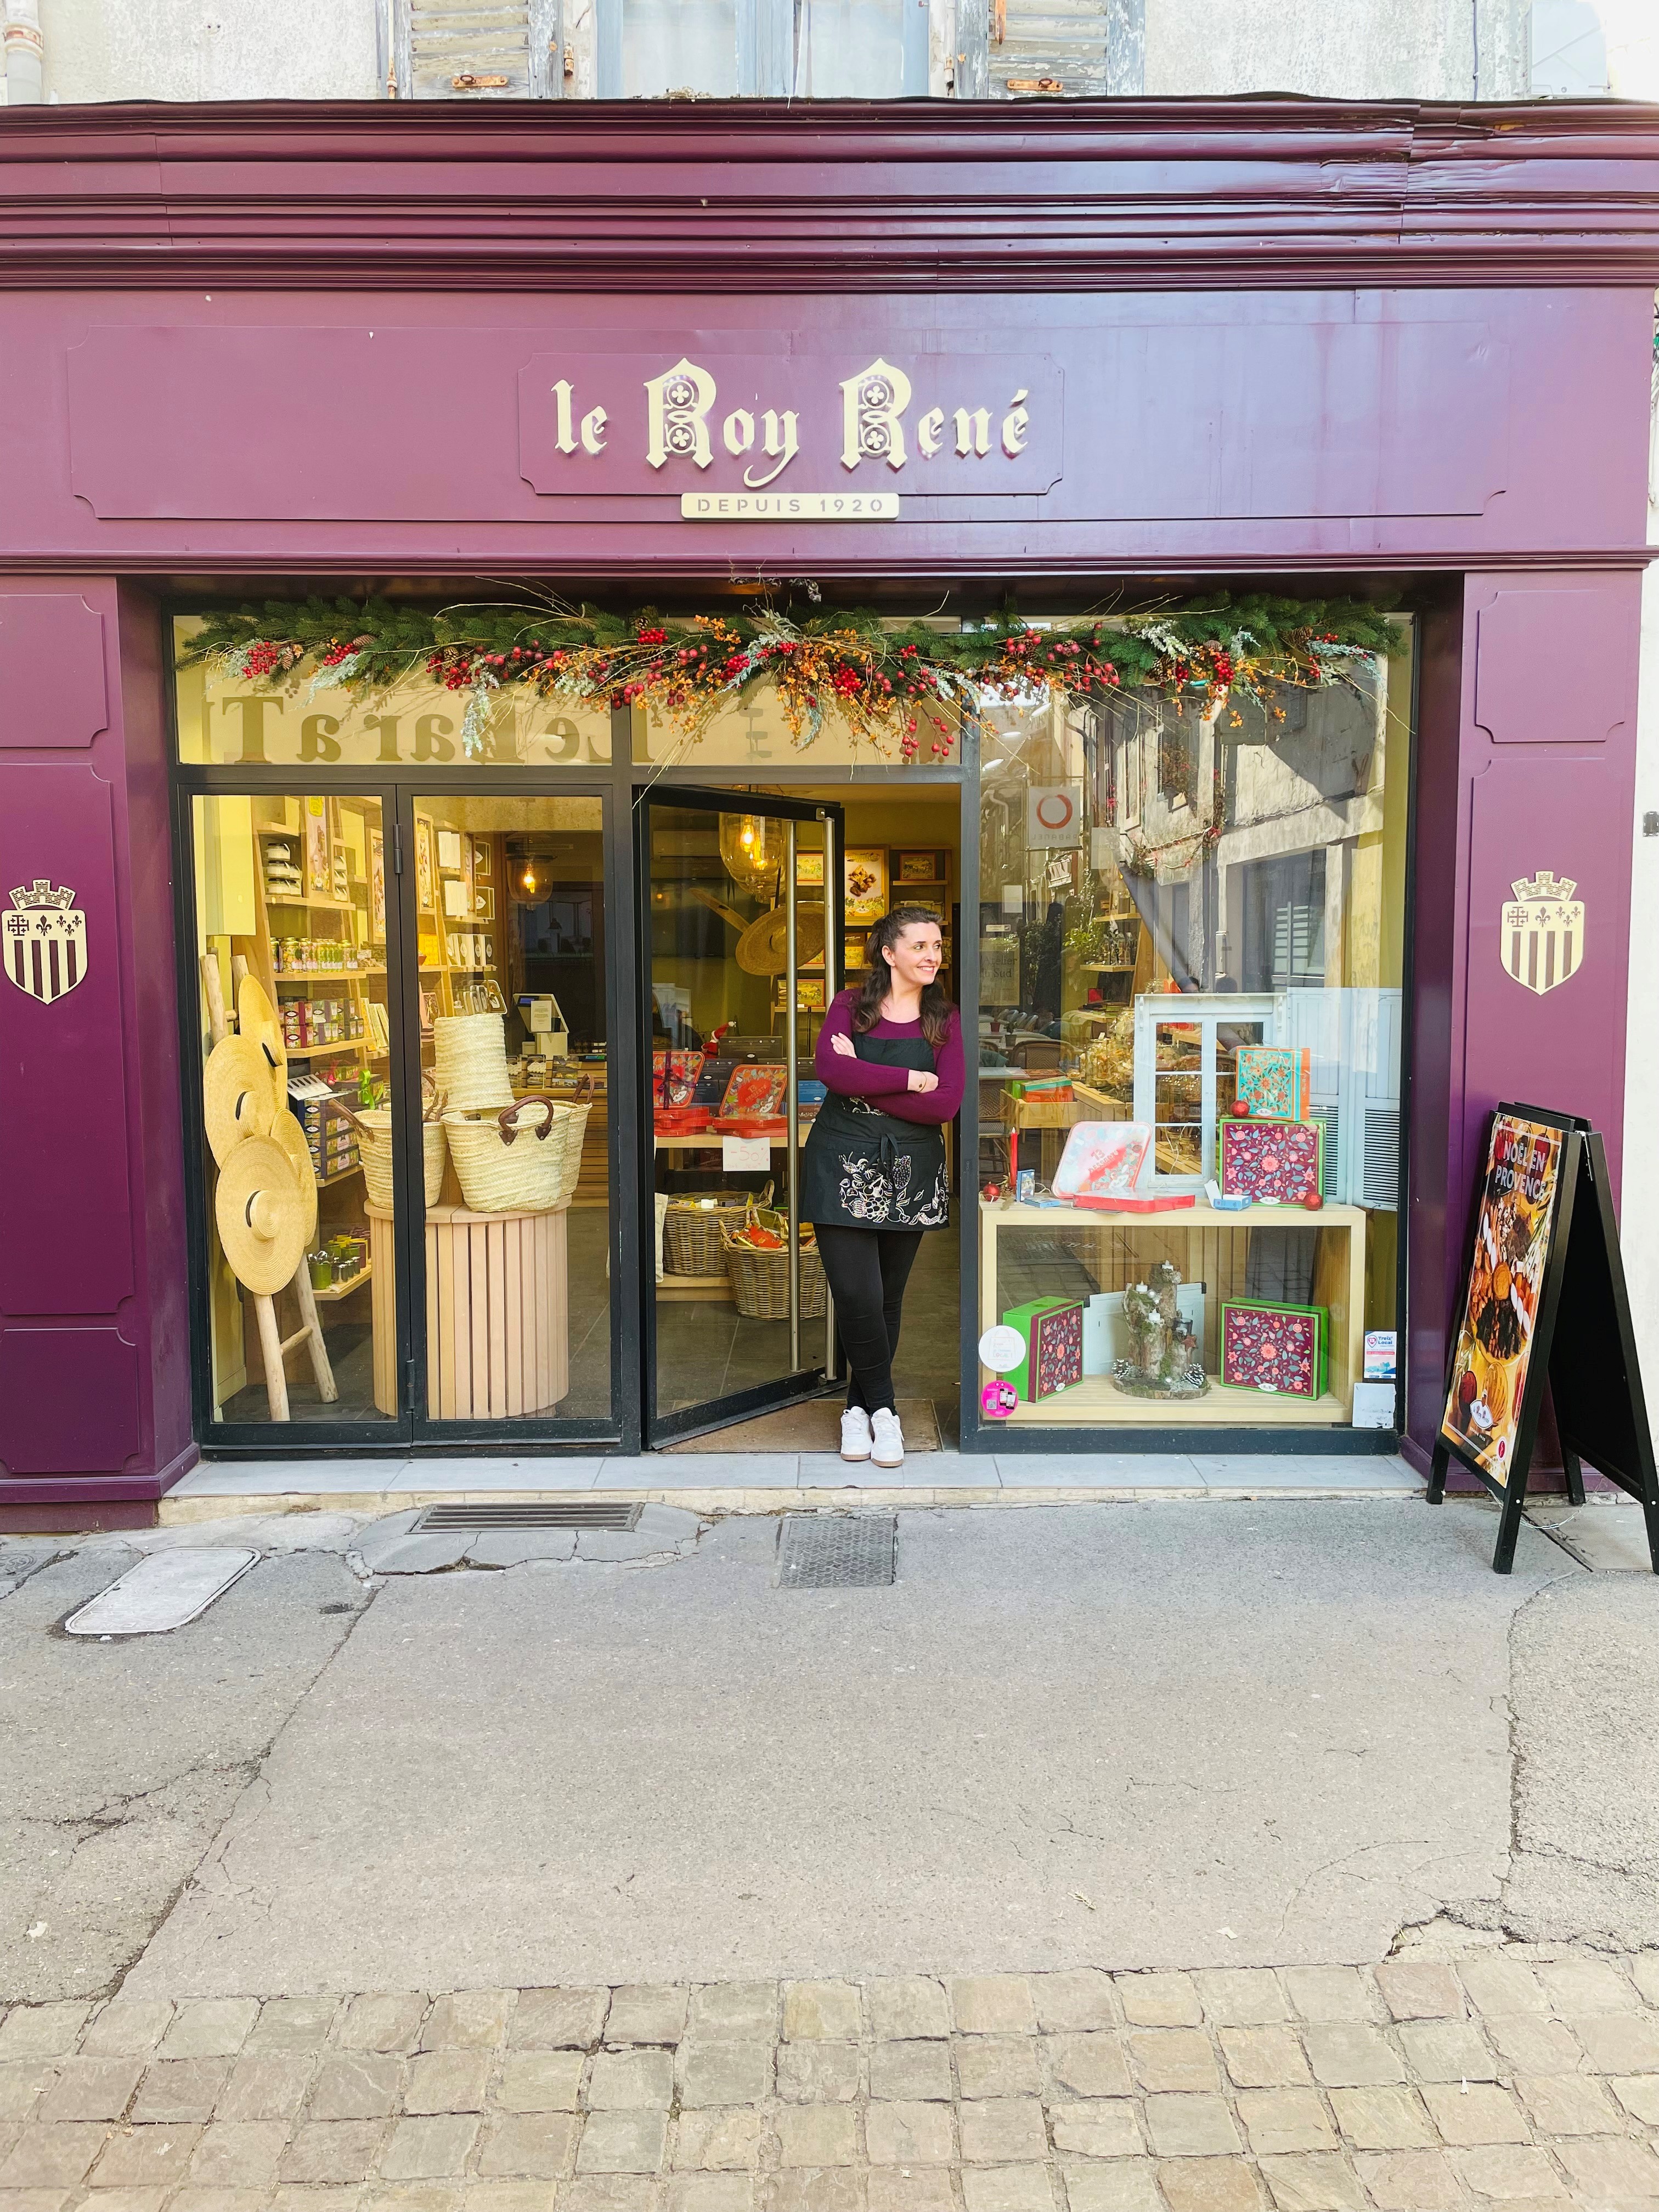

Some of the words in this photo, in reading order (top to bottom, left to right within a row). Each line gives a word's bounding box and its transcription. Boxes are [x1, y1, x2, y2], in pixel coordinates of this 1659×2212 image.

[550, 379, 608, 455] le
[644, 357, 800, 487] Roy
[839, 357, 1030, 470] René
[697, 499, 803, 512] DEPUIS
[820, 499, 884, 512] 1920
[994, 968, 1012, 978] Sud
[1503, 1141, 1528, 1166] NOËL
[1531, 1150, 1546, 1172] EN
[1494, 1165, 1547, 1201] PROVENCE
